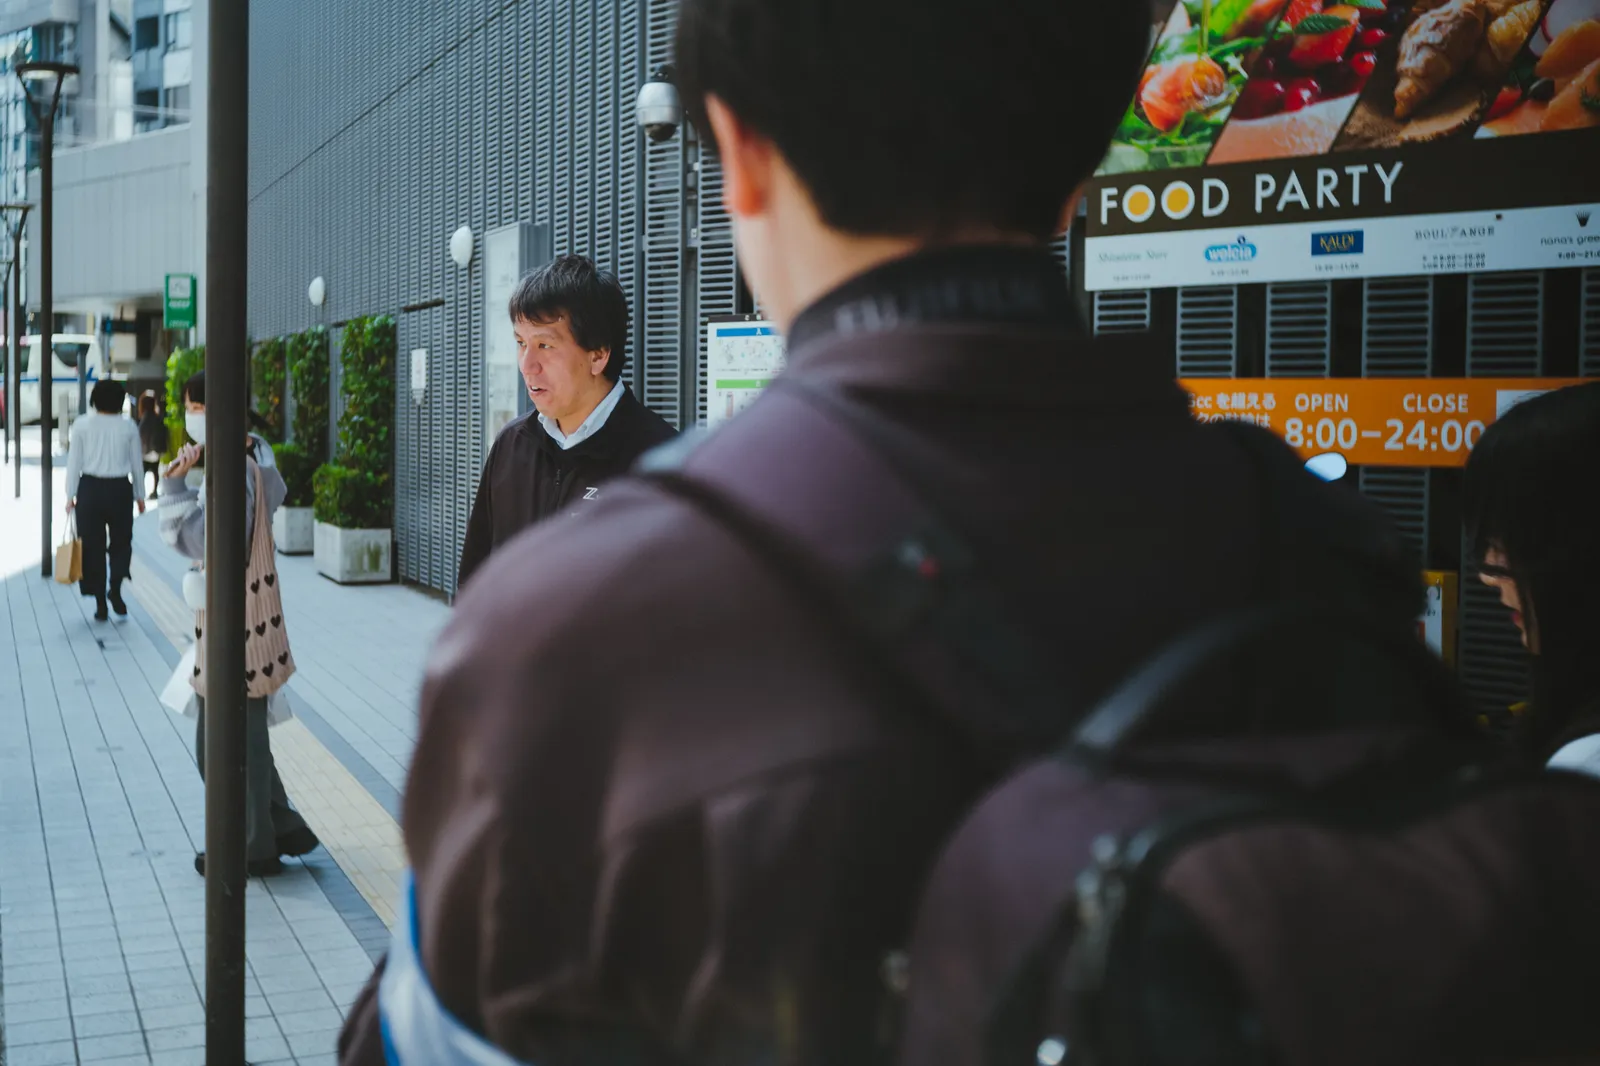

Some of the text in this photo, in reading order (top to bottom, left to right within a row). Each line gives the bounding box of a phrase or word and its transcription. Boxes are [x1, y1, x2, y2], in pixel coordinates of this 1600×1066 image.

[1100, 161, 1404, 225] FOOD PARTY
[1295, 393, 1348, 412] OPEN
[1403, 393, 1469, 413] CLOSE
